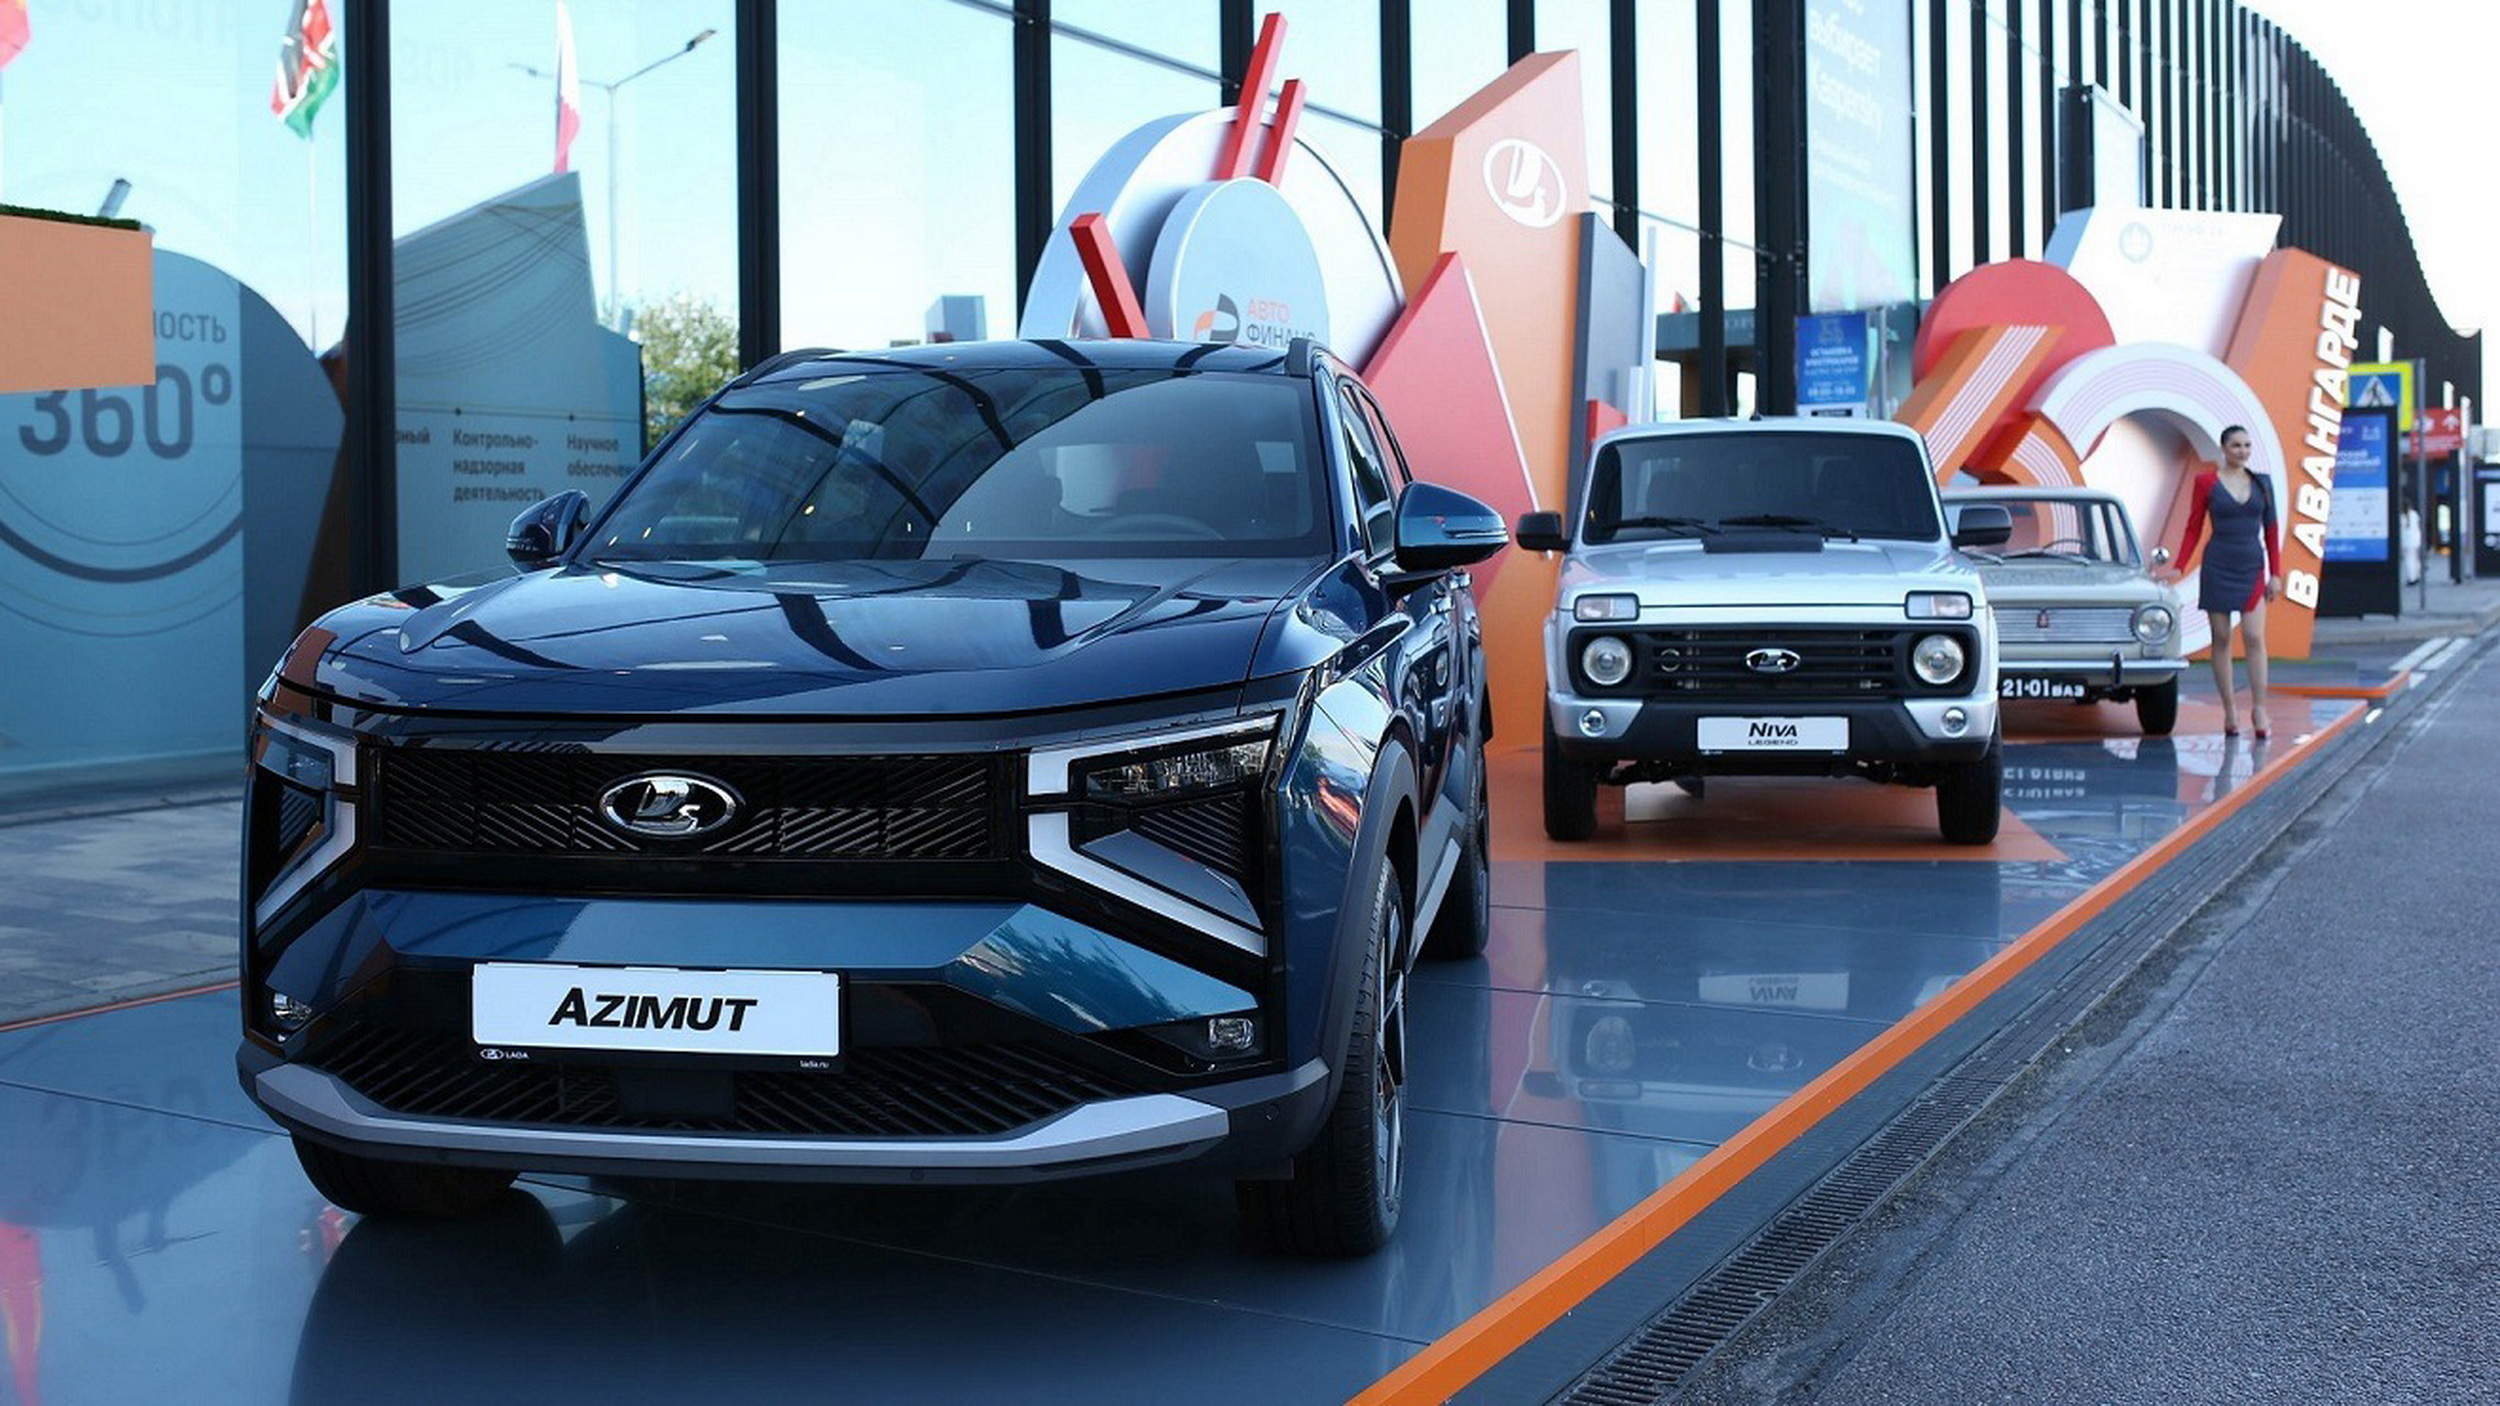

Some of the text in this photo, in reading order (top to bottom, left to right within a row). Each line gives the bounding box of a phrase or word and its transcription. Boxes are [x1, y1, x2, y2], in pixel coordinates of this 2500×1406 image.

[1247, 298, 1290, 323] АВТО
[2293, 267, 2361, 559] АВАНГАРДЕ
[453, 428, 538, 450] Контрольно-
[567, 433, 619, 454] Научное
[453, 459, 525, 477] надзорная
[454, 487, 546, 503] деятельность
[2286, 568, 2320, 610] В
[1749, 722, 1798, 737] NIVA
[548, 987, 758, 1032] AZIMUT
[505, 1050, 530, 1060] LADA
